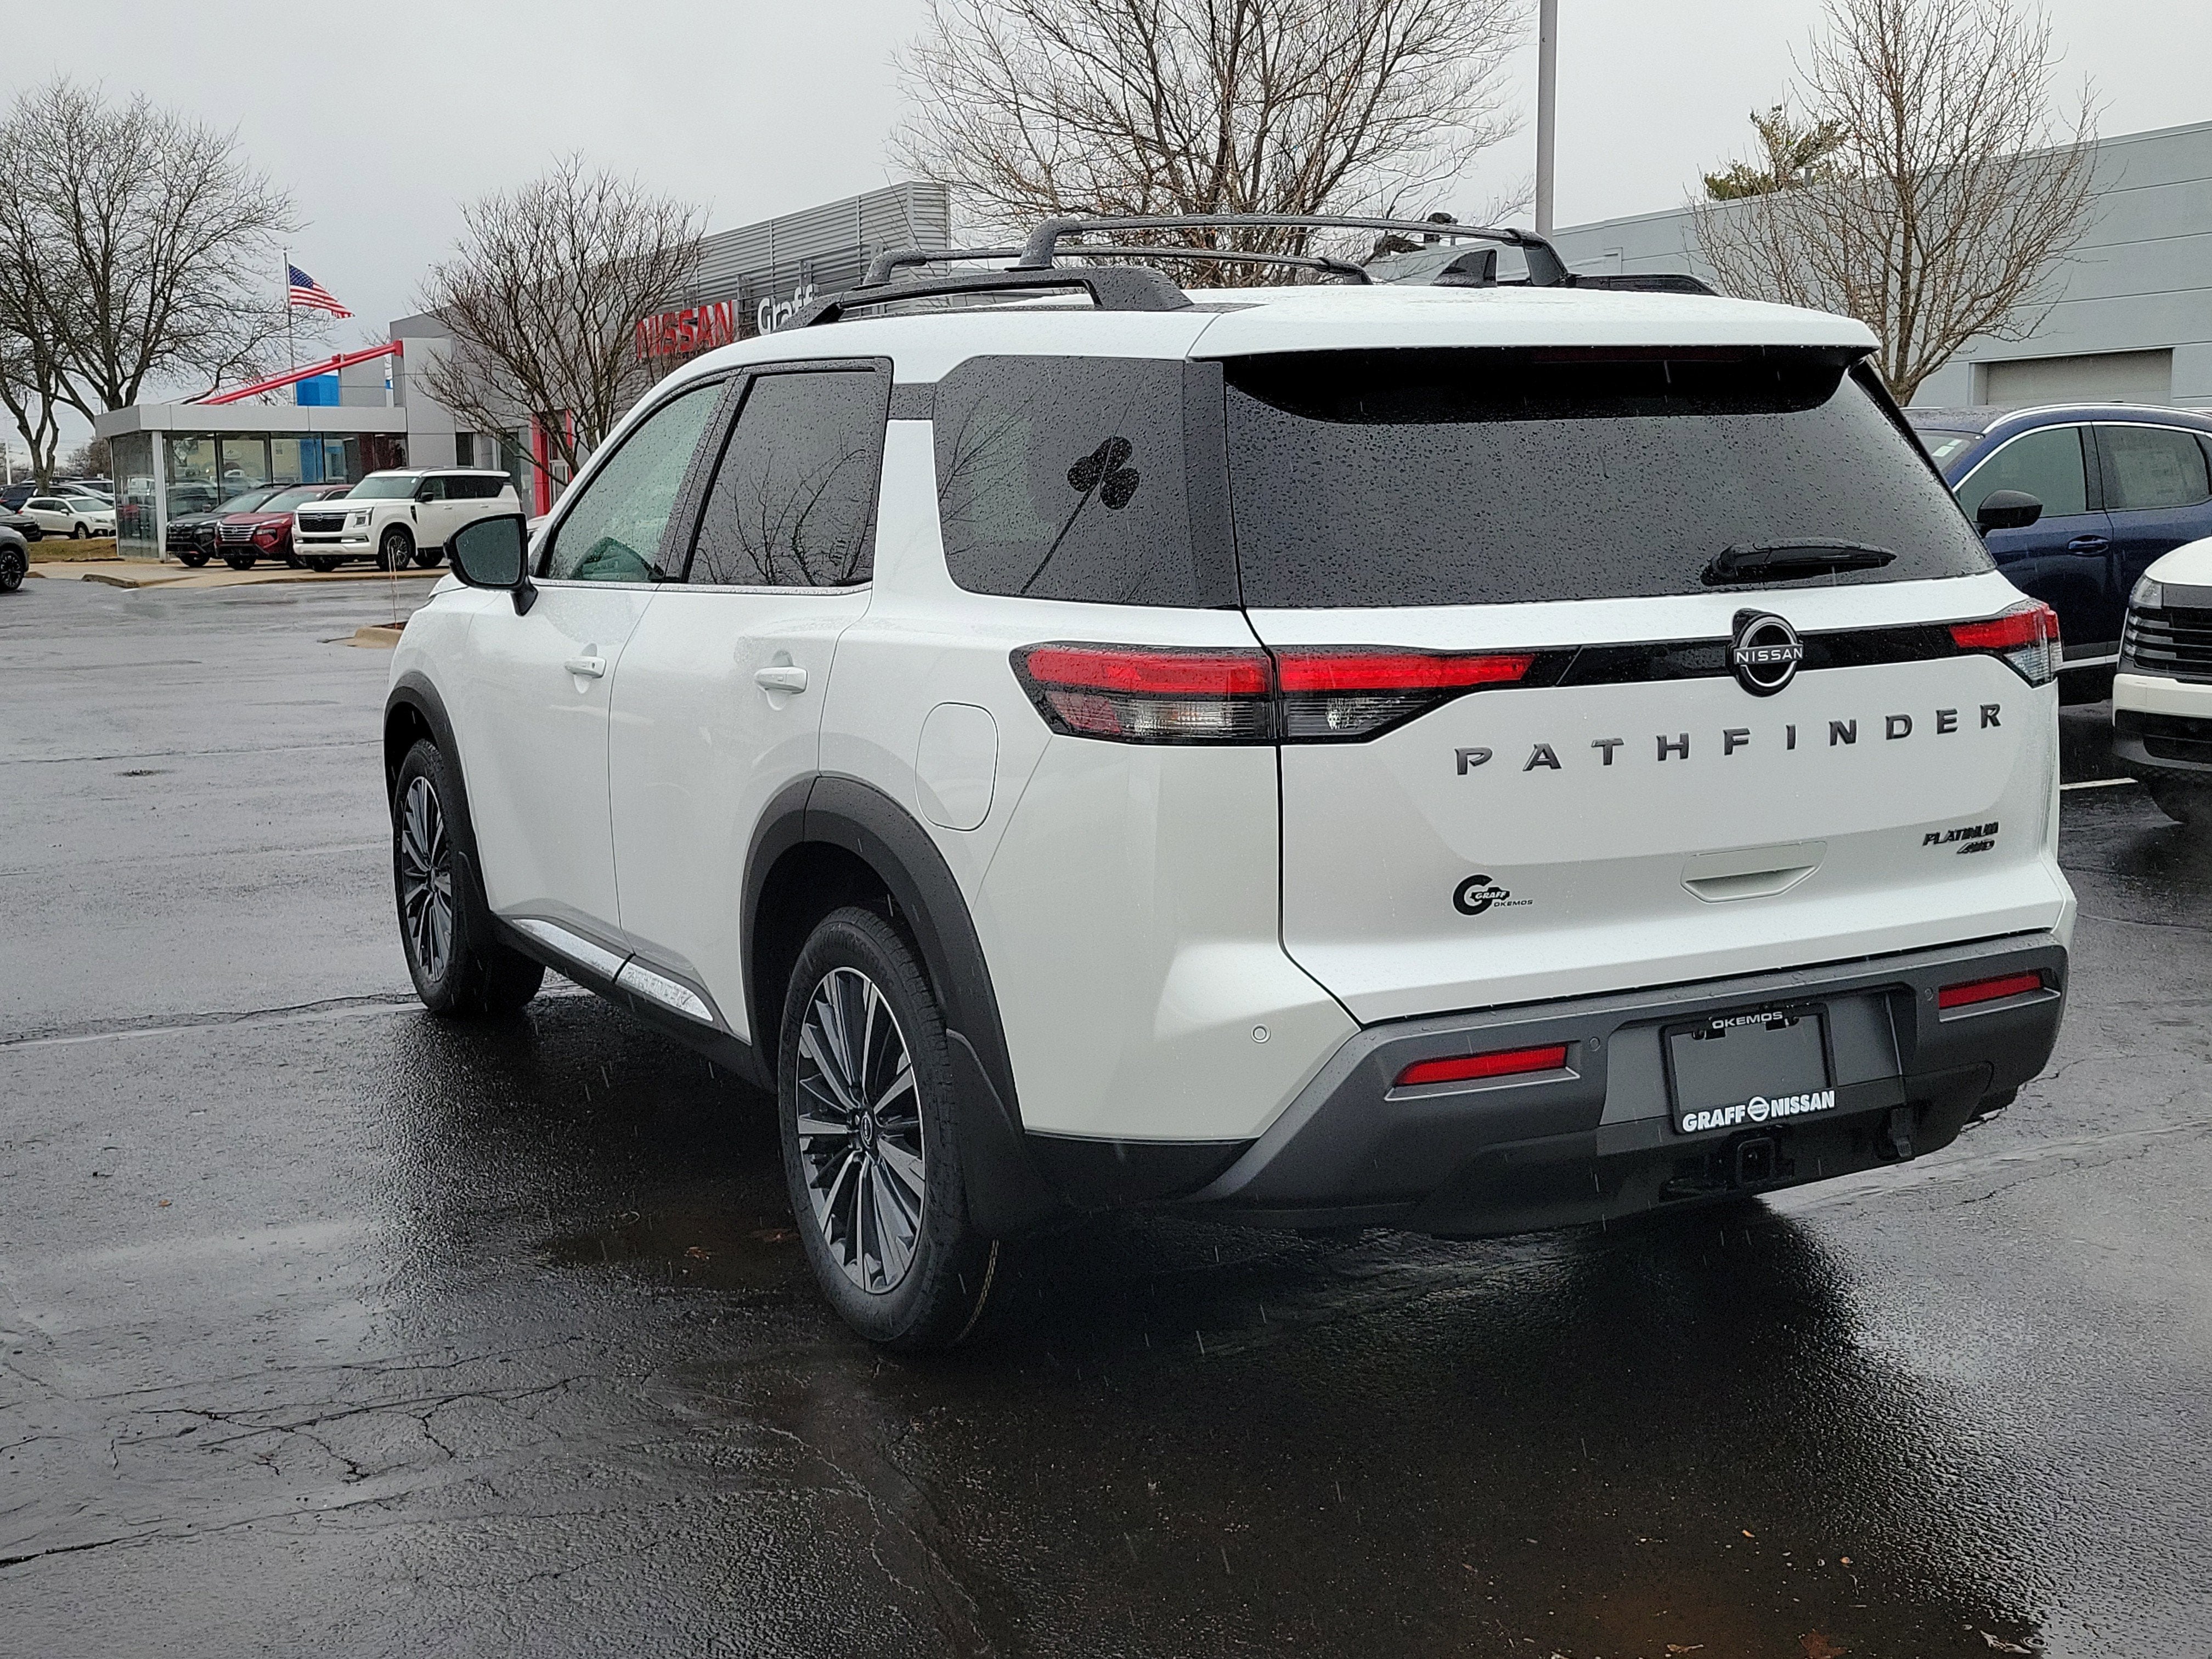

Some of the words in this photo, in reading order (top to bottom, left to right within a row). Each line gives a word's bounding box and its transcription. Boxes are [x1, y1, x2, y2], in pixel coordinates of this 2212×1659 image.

[636, 300, 734, 359] NISSAN
[1736, 647, 1803, 663] NISSAN
[1454, 703, 2002, 775] PATHFINDER
[1475, 891, 1506, 899] GRAFF
[1712, 1011, 1784, 1029] OKEMOS
[1682, 1104, 1746, 1132] GRAFF
[1771, 1090, 1835, 1118] NISSAN
